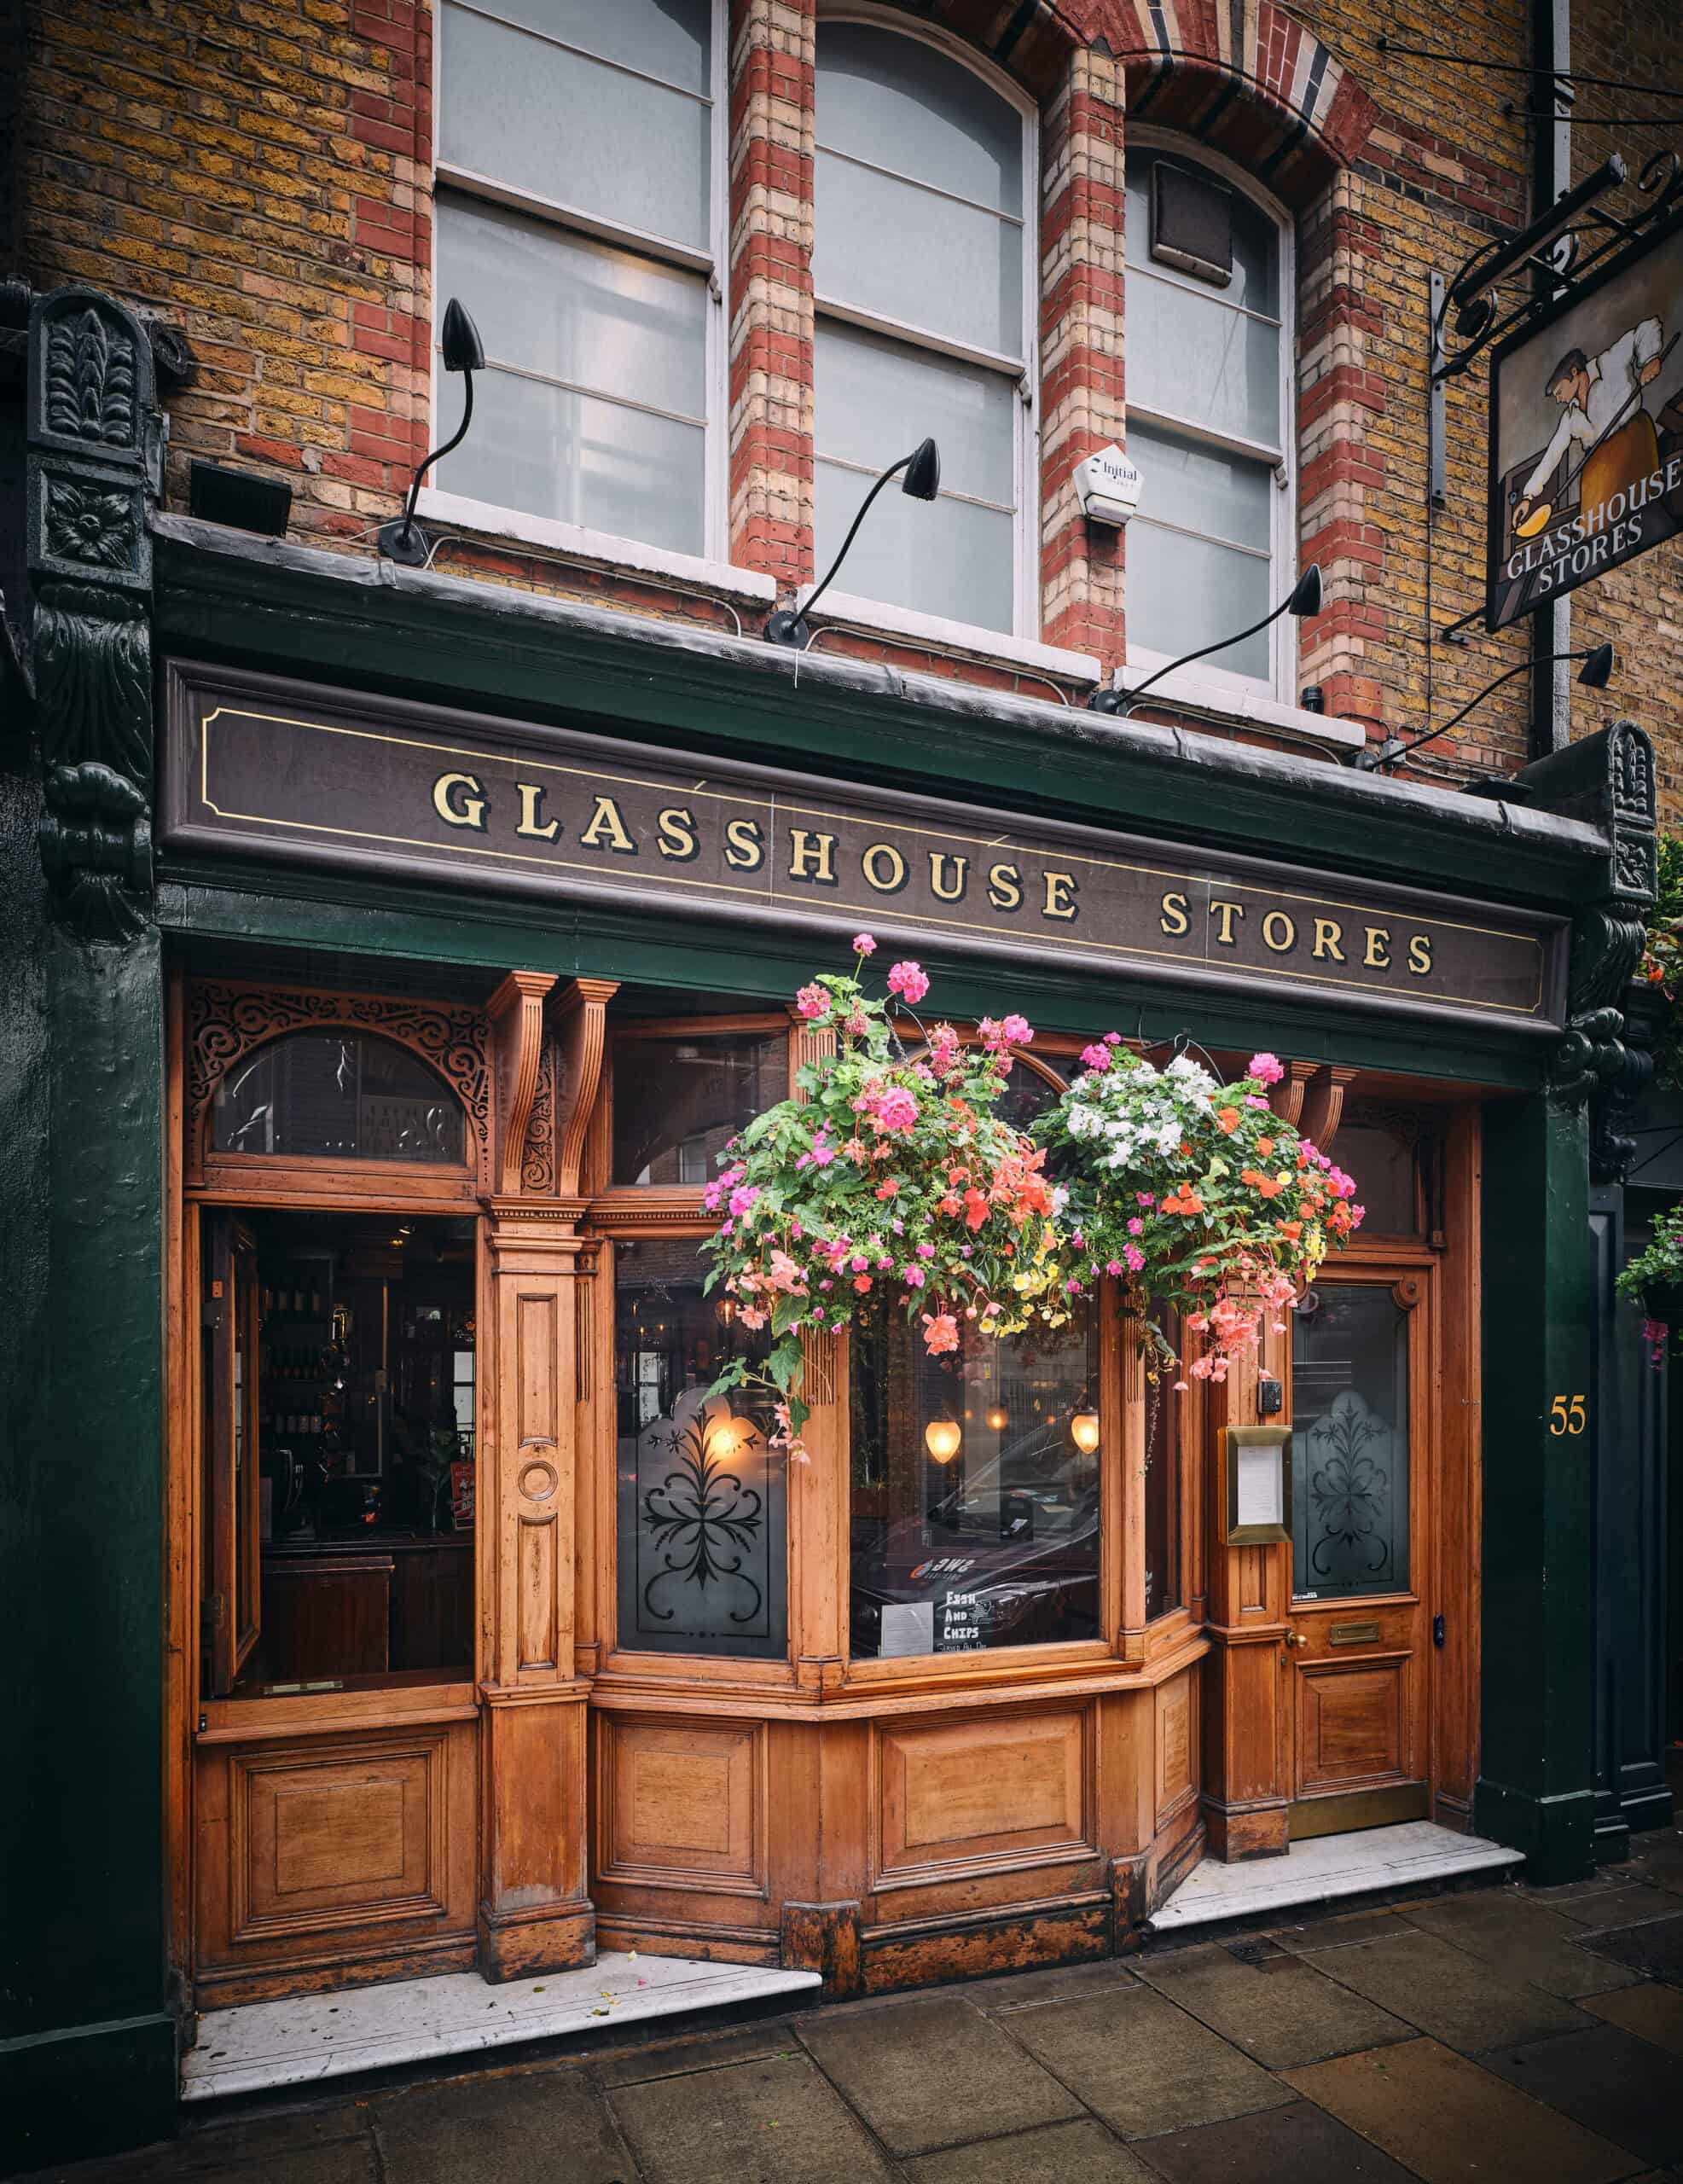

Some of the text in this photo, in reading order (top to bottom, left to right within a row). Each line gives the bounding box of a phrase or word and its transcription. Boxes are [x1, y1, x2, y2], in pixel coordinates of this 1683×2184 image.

[1104, 461, 1137, 481] Initial
[1507, 458, 1682, 580] GLASSHOUSE
[1539, 513, 1643, 594] STORES
[432, 772, 1435, 976] GLASSHOUSE STORES
[1549, 1394, 1586, 1435] 55
[943, 1626, 979, 1640] CHIPS
